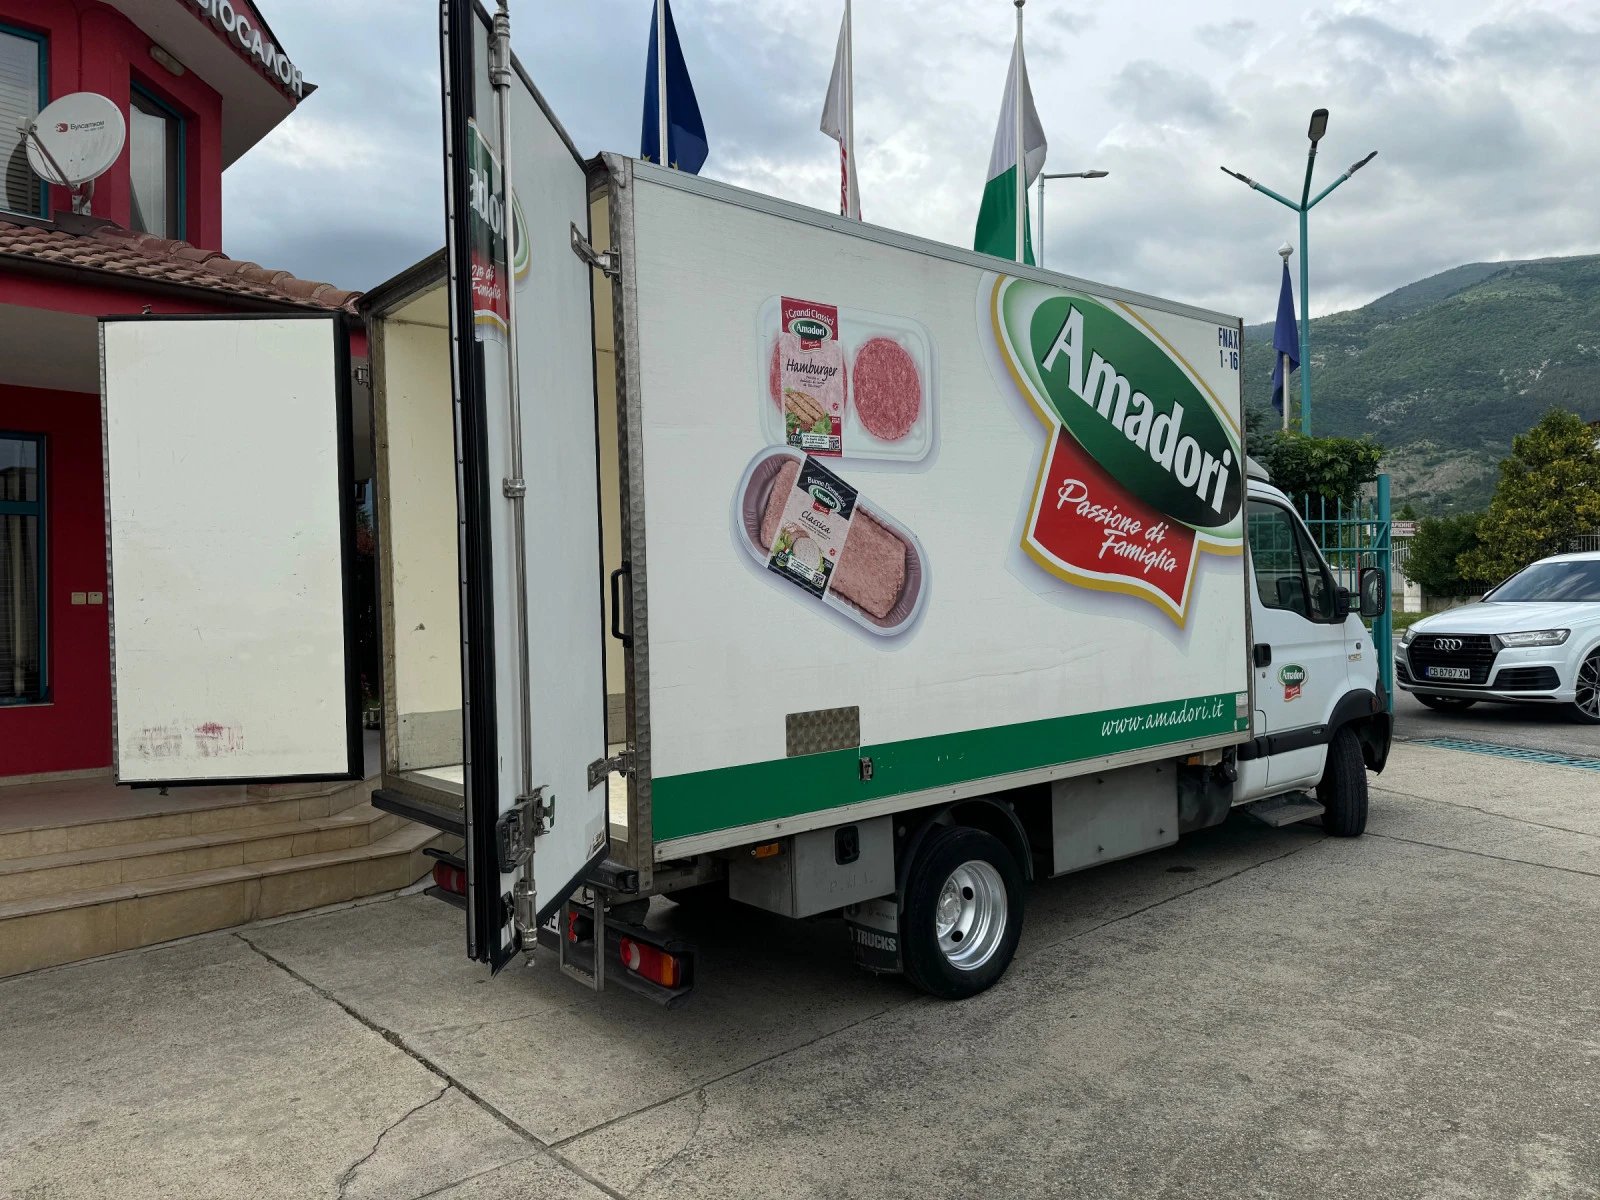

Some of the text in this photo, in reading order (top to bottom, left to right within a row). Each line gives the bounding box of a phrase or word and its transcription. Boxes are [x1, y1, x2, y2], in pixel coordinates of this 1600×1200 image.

[197, 0, 302, 98] ОСАЛОН
[788, 309, 811, 318] Grandi
[811, 309, 835, 326] Classici
[797, 323, 825, 336] Amadori
[1218, 327, 1239, 350] FNAX
[786, 358, 838, 381] Hamburger
[1042, 302, 1231, 515] Amadori
[801, 510, 831, 534] Classica
[1058, 478, 1169, 544] Passione di
[1099, 528, 1177, 573] Famiglia
[1282, 669, 1304, 680] Amadori
[1101, 697, 1225, 737] www.amadori.it
[856, 929, 897, 952] TRUCKS
